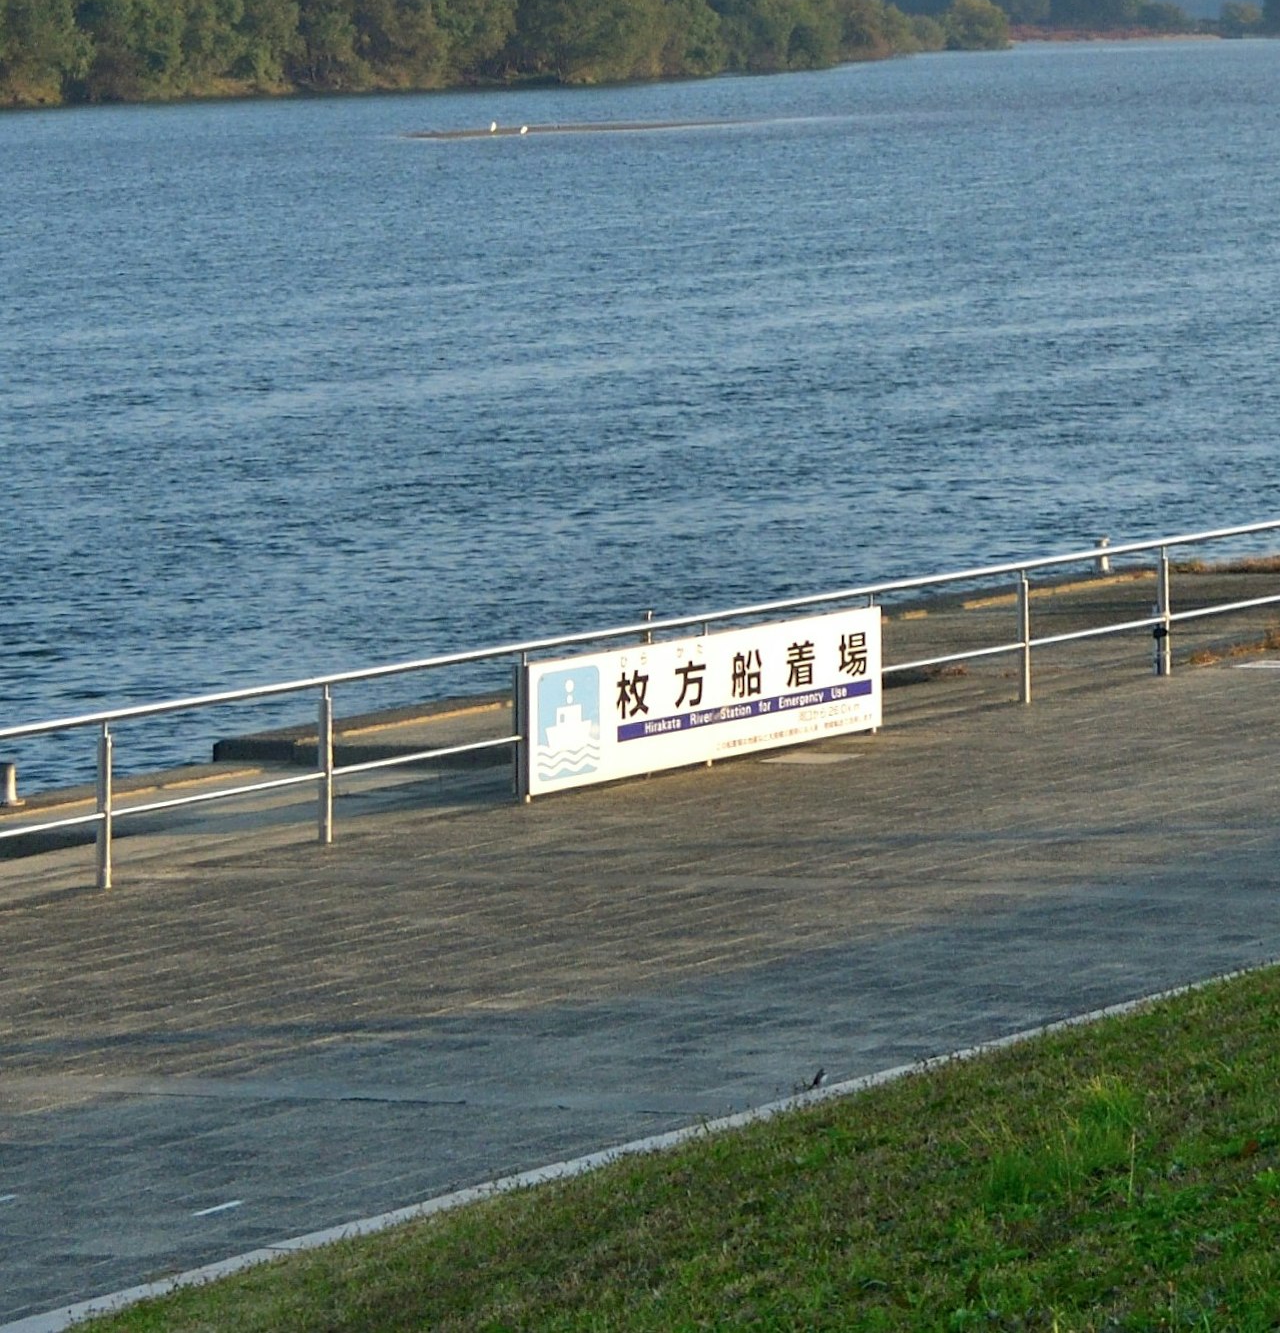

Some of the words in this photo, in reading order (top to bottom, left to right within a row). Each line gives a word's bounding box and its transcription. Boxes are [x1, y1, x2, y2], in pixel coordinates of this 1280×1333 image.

[616, 631, 868, 720] 枚方船着場
[644, 717, 681, 735] Hirakata
[720, 704, 752, 720] Station
[758, 700, 771, 712] for
[778, 690, 825, 709] Emergency
[830, 686, 848, 699] Use
